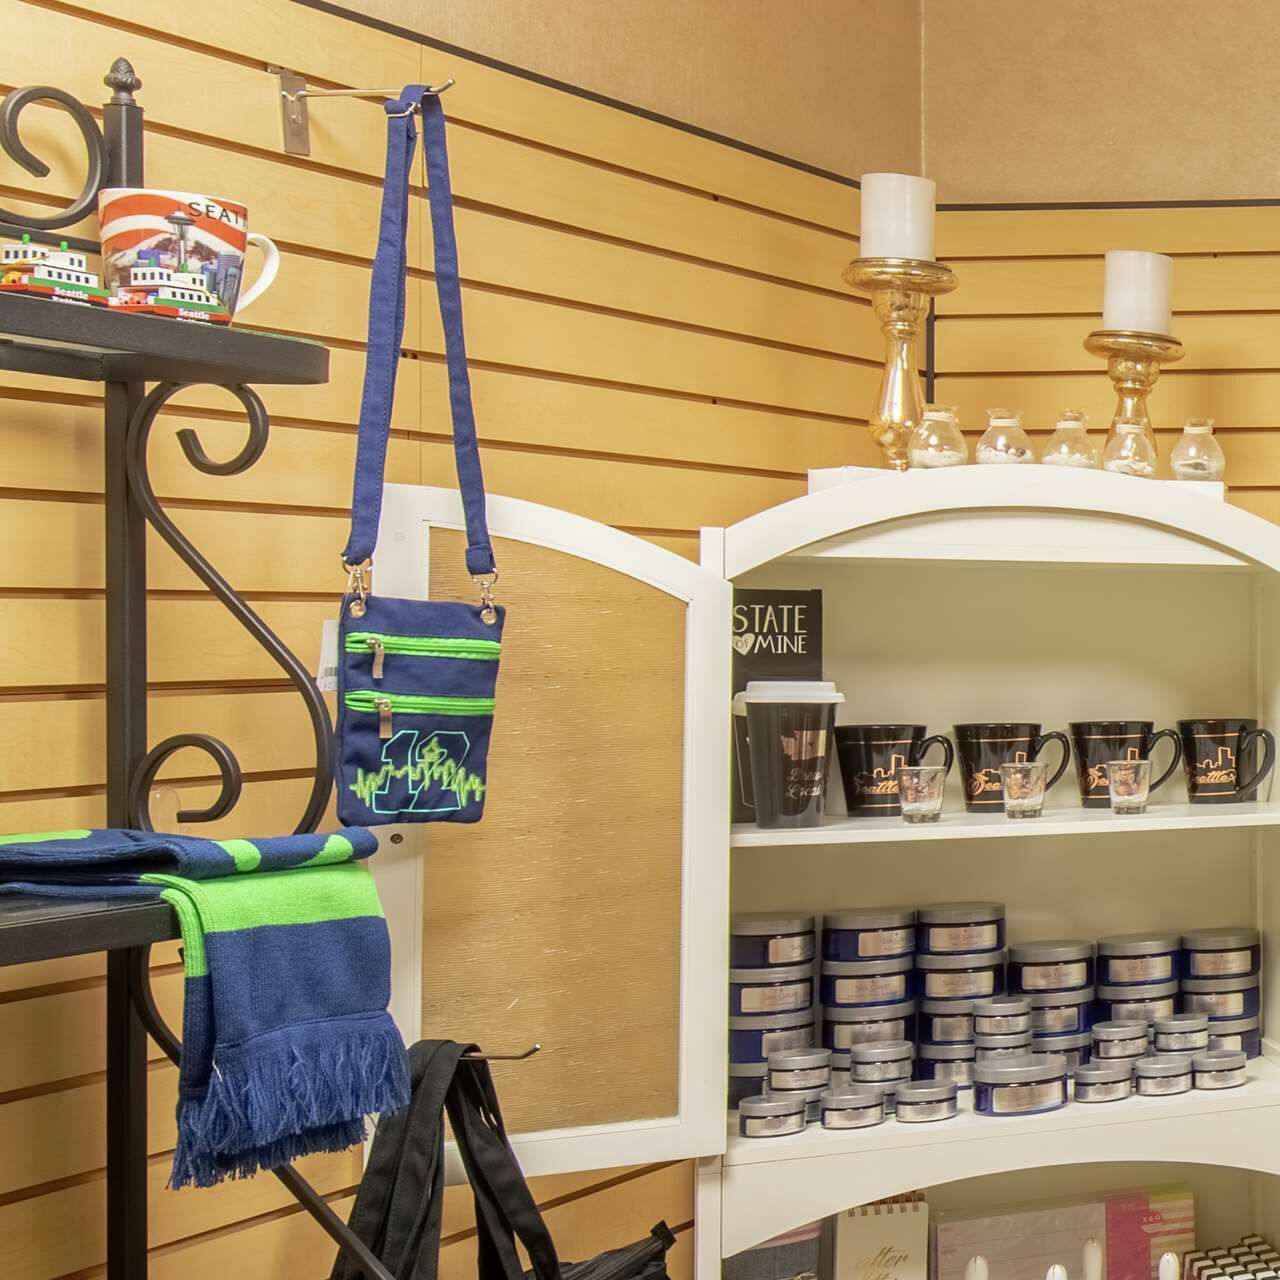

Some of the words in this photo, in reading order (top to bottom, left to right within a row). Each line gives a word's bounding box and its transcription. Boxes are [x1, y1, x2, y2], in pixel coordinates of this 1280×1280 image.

[54, 287, 89, 300] Seattle
[178, 308, 209, 320] Seattle
[733, 605, 808, 633] STATE
[754, 635, 808, 654] MINE
